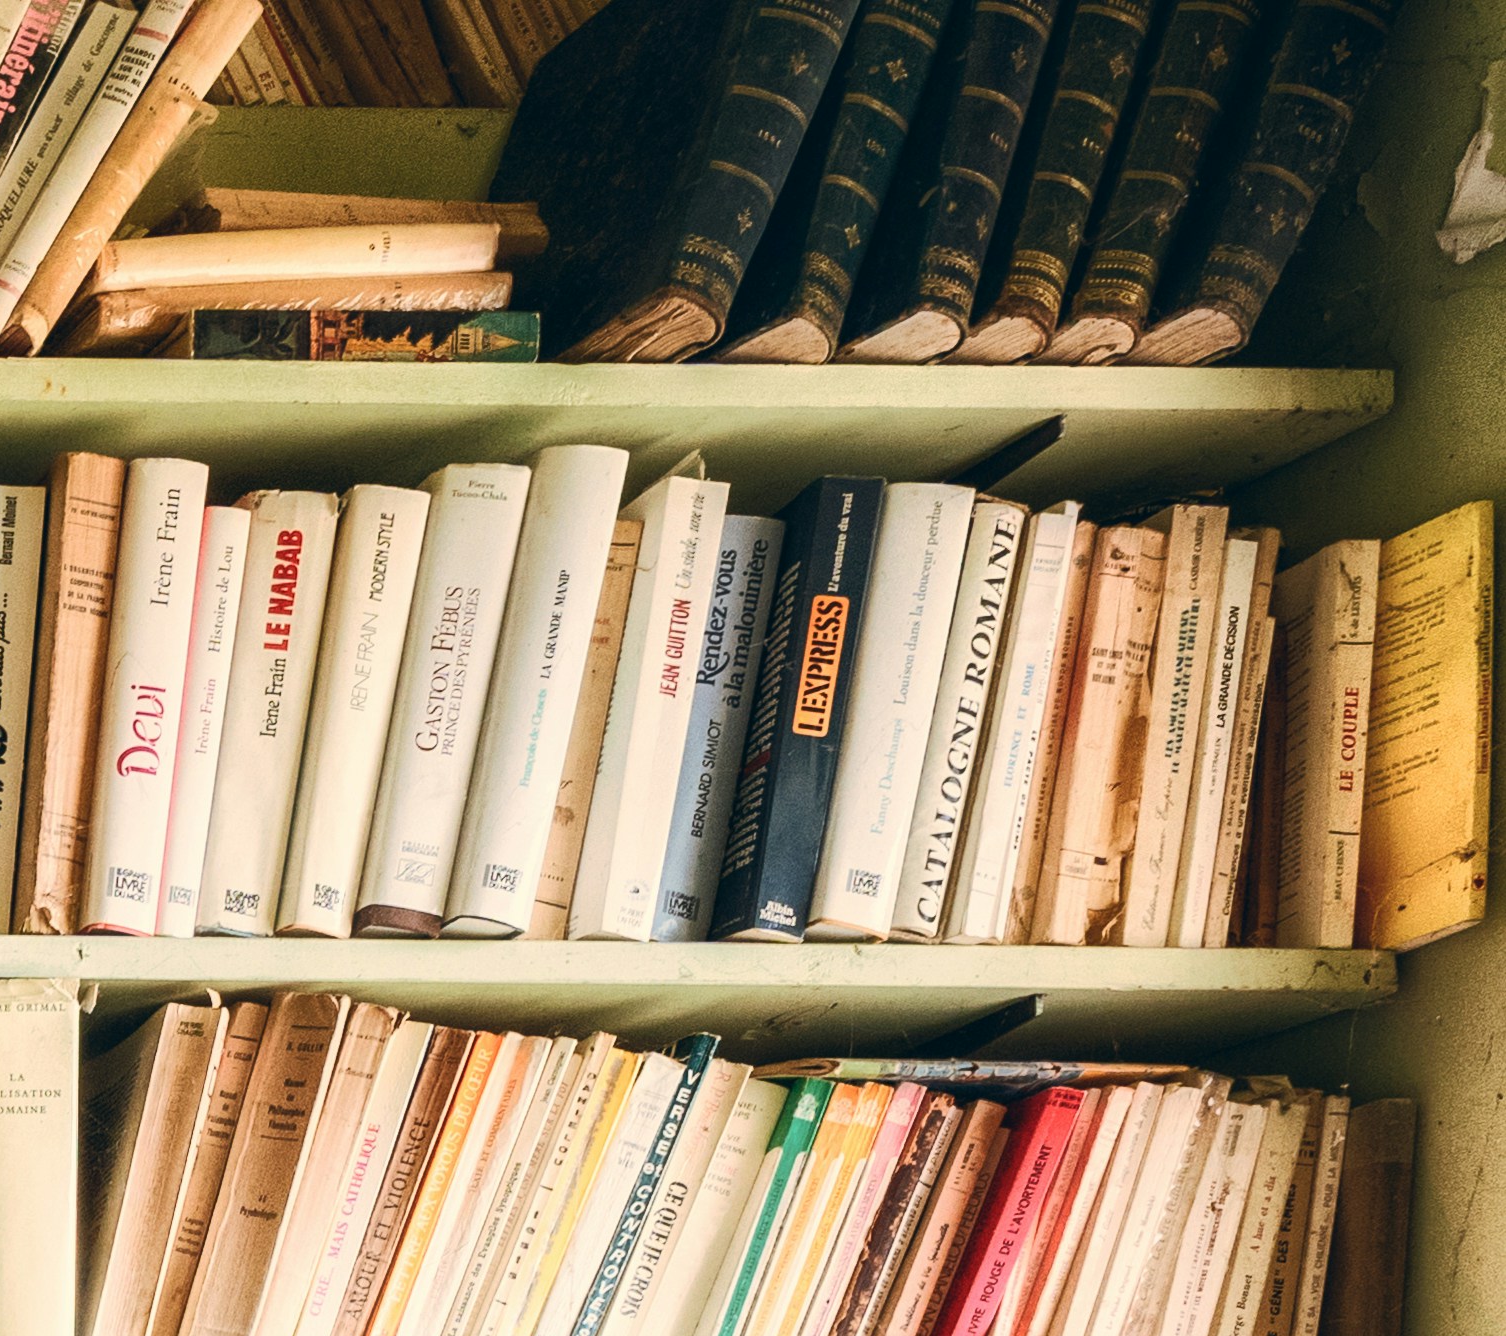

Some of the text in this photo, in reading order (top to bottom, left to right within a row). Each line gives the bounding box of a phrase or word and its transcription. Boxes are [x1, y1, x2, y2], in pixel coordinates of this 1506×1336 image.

[0, 496, 17, 565] Bernard Moinet
[149, 488, 181, 606] Irène Frain
[263, 529, 303, 651] LE NABAB
[658, 599, 691, 698] JEAN GUITTON
[695, 549, 738, 686] Rendez-vous
[724, 539, 769, 708] à la malouinière
[915, 519, 1017, 923] CATALOGNE ROMANE
[1215, 606, 1241, 728] LA GRANDE DÉCISION
[691, 719, 722, 838] BERNARD SIMIOT
[1338, 686, 1359, 791] LE COUPLE
[344, 1116, 431, 1321] AMOUR ET VIOLENCE
[996, 1238, 1011, 1256] DE
[1003, 1144, 1053, 1234] L'AVORTEMENT
[977, 1260, 1005, 1303] ROUGE
